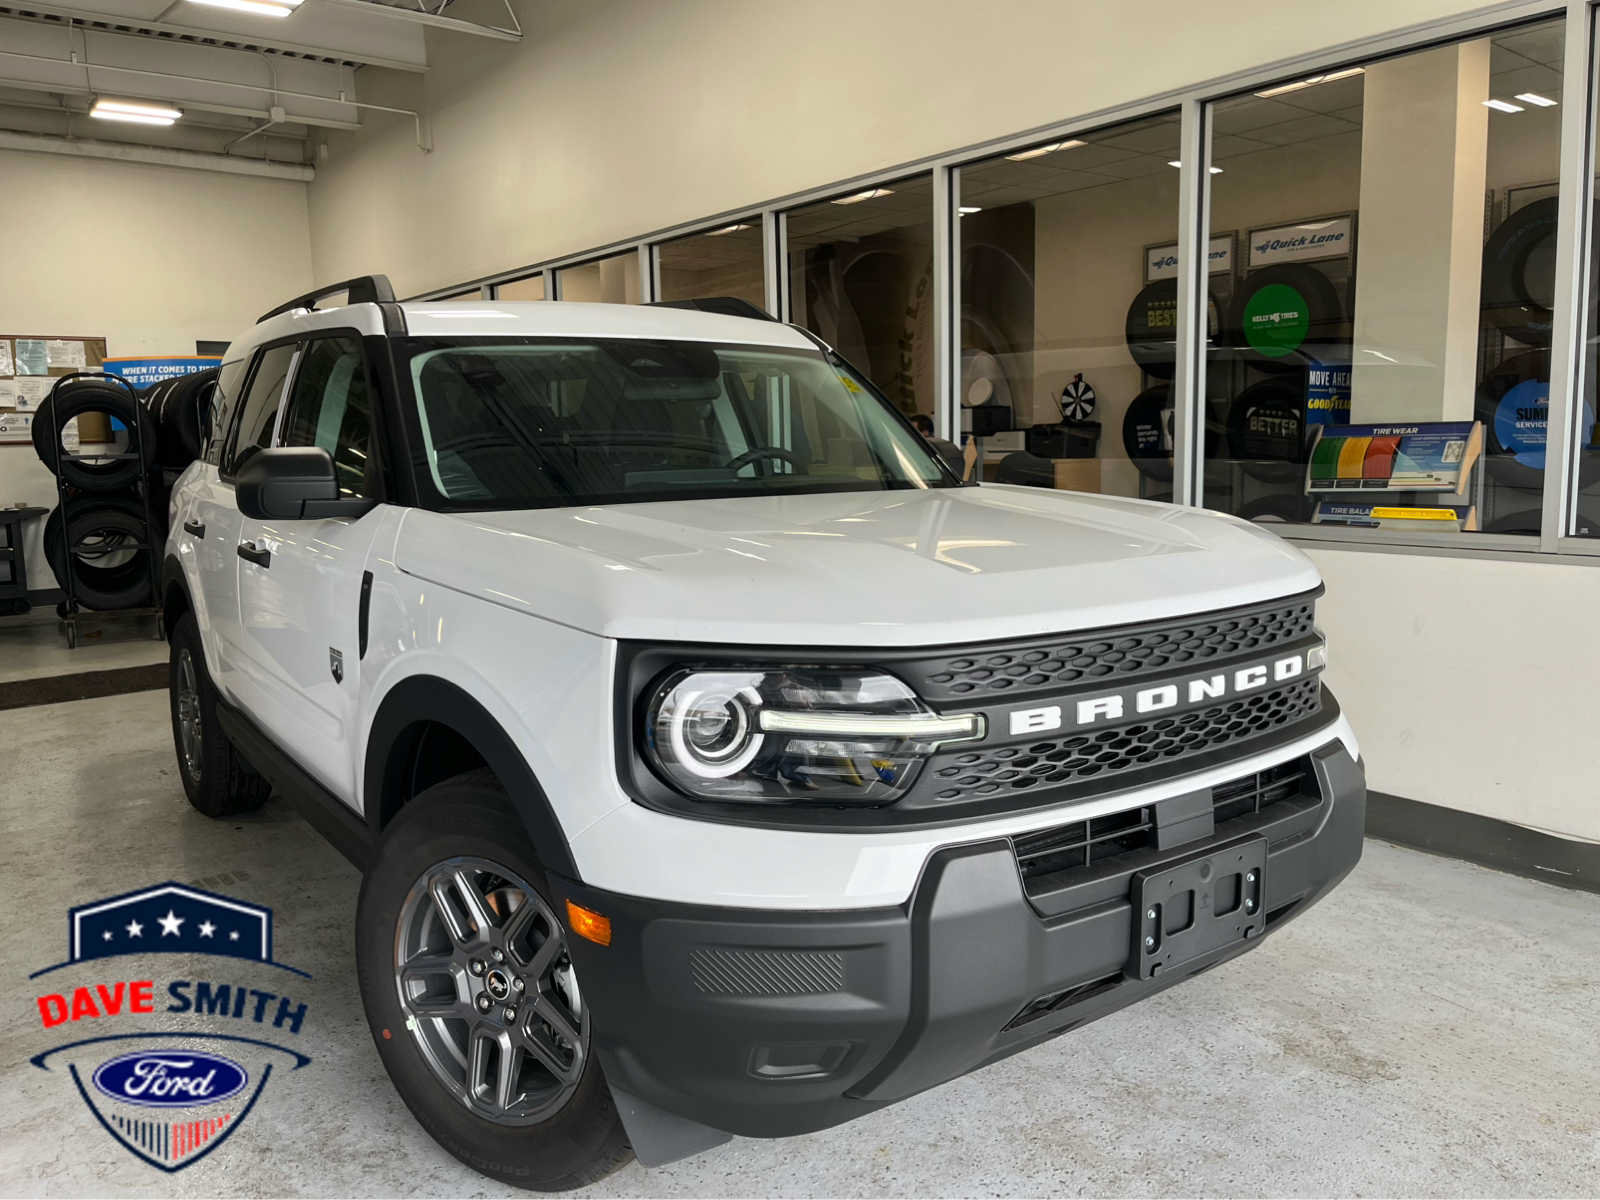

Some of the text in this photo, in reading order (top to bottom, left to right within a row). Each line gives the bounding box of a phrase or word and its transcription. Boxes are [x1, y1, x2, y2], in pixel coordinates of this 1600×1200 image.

[1270, 236, 1307, 250] Quick
[1309, 232, 1345, 244] Lane
[122, 366, 146, 375] WHEN
[149, 366, 156, 374] IT
[158, 365, 185, 374] COMES
[187, 365, 197, 373] TO
[1309, 370, 1352, 386] MOVE AHEA
[1249, 416, 1298, 434] BETTER
[1392, 427, 1418, 435] WEAR
[1009, 655, 1302, 736] BRONCO
